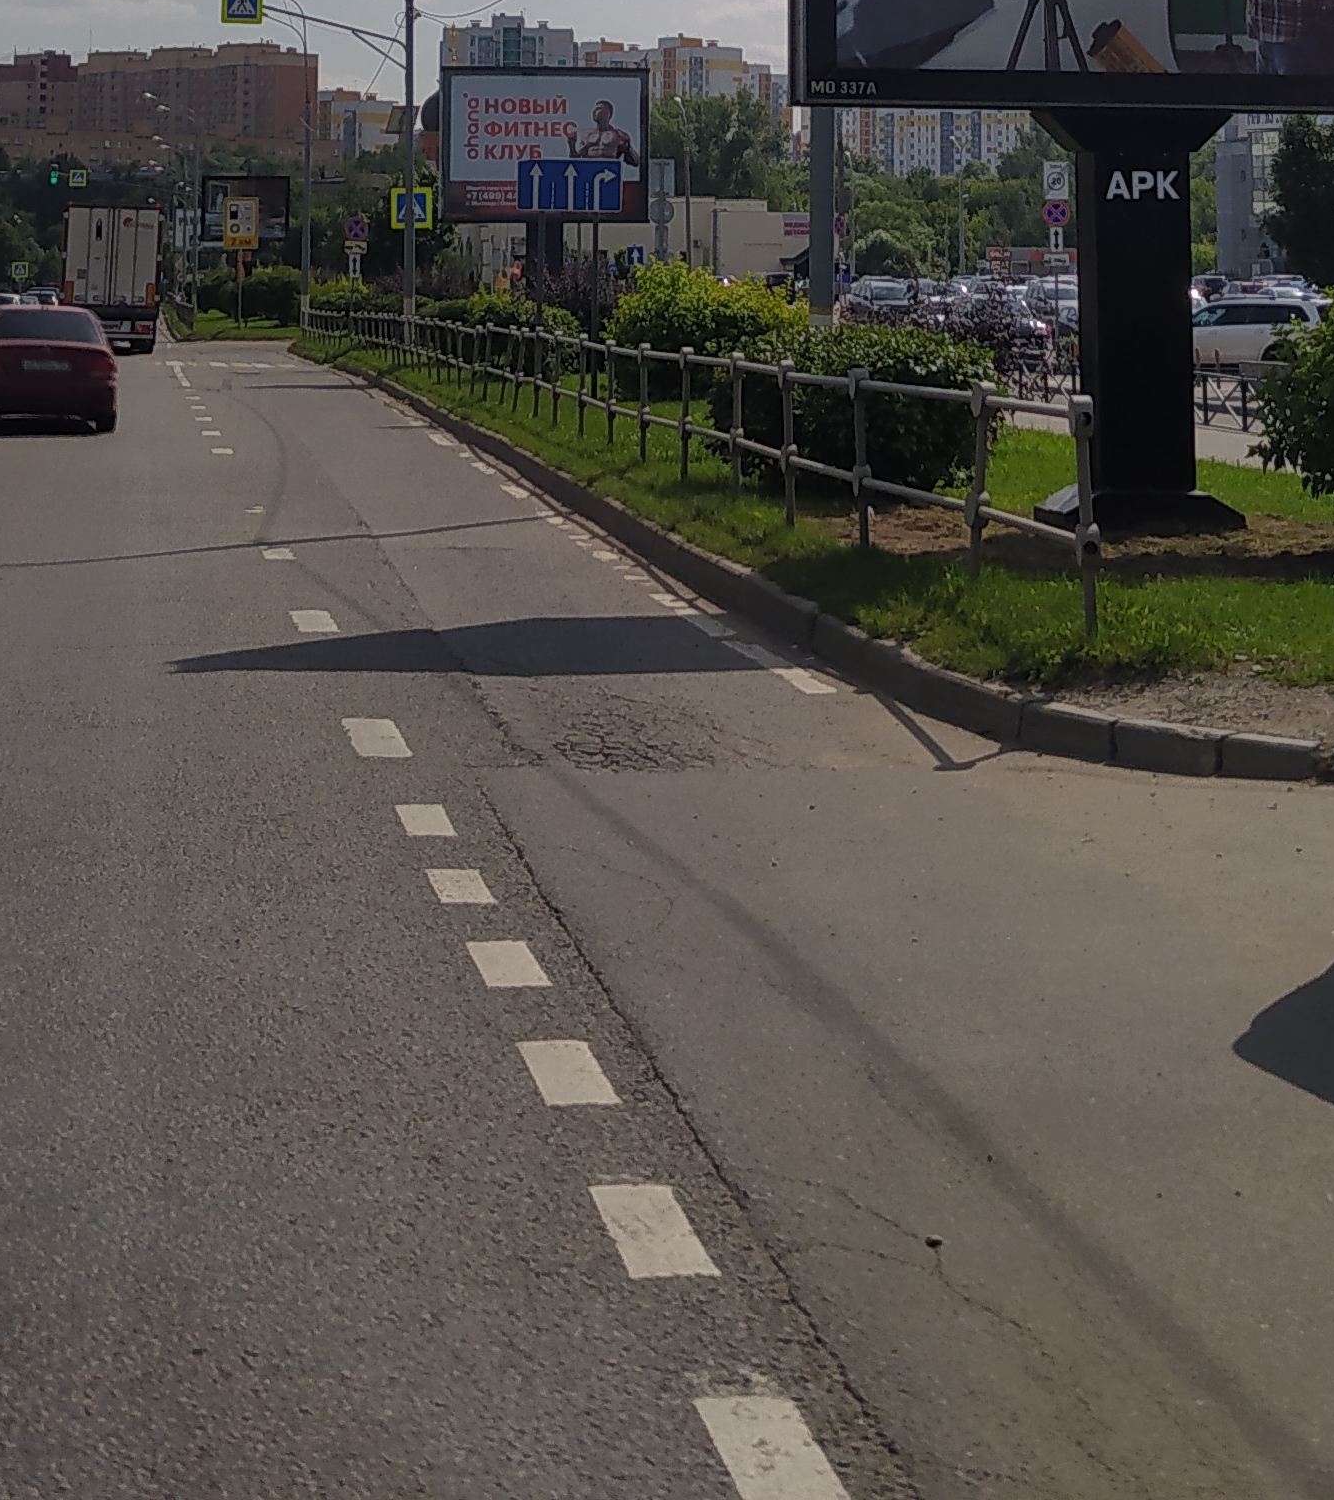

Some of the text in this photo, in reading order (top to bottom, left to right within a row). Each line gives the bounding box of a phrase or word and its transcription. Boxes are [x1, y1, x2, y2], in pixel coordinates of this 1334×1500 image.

[484, 94, 567, 115] НОВЫЙ
[483, 120, 578, 138] ФИТНЕС
[484, 143, 542, 160] КЛУБ
[1105, 170, 1181, 200] АРК
